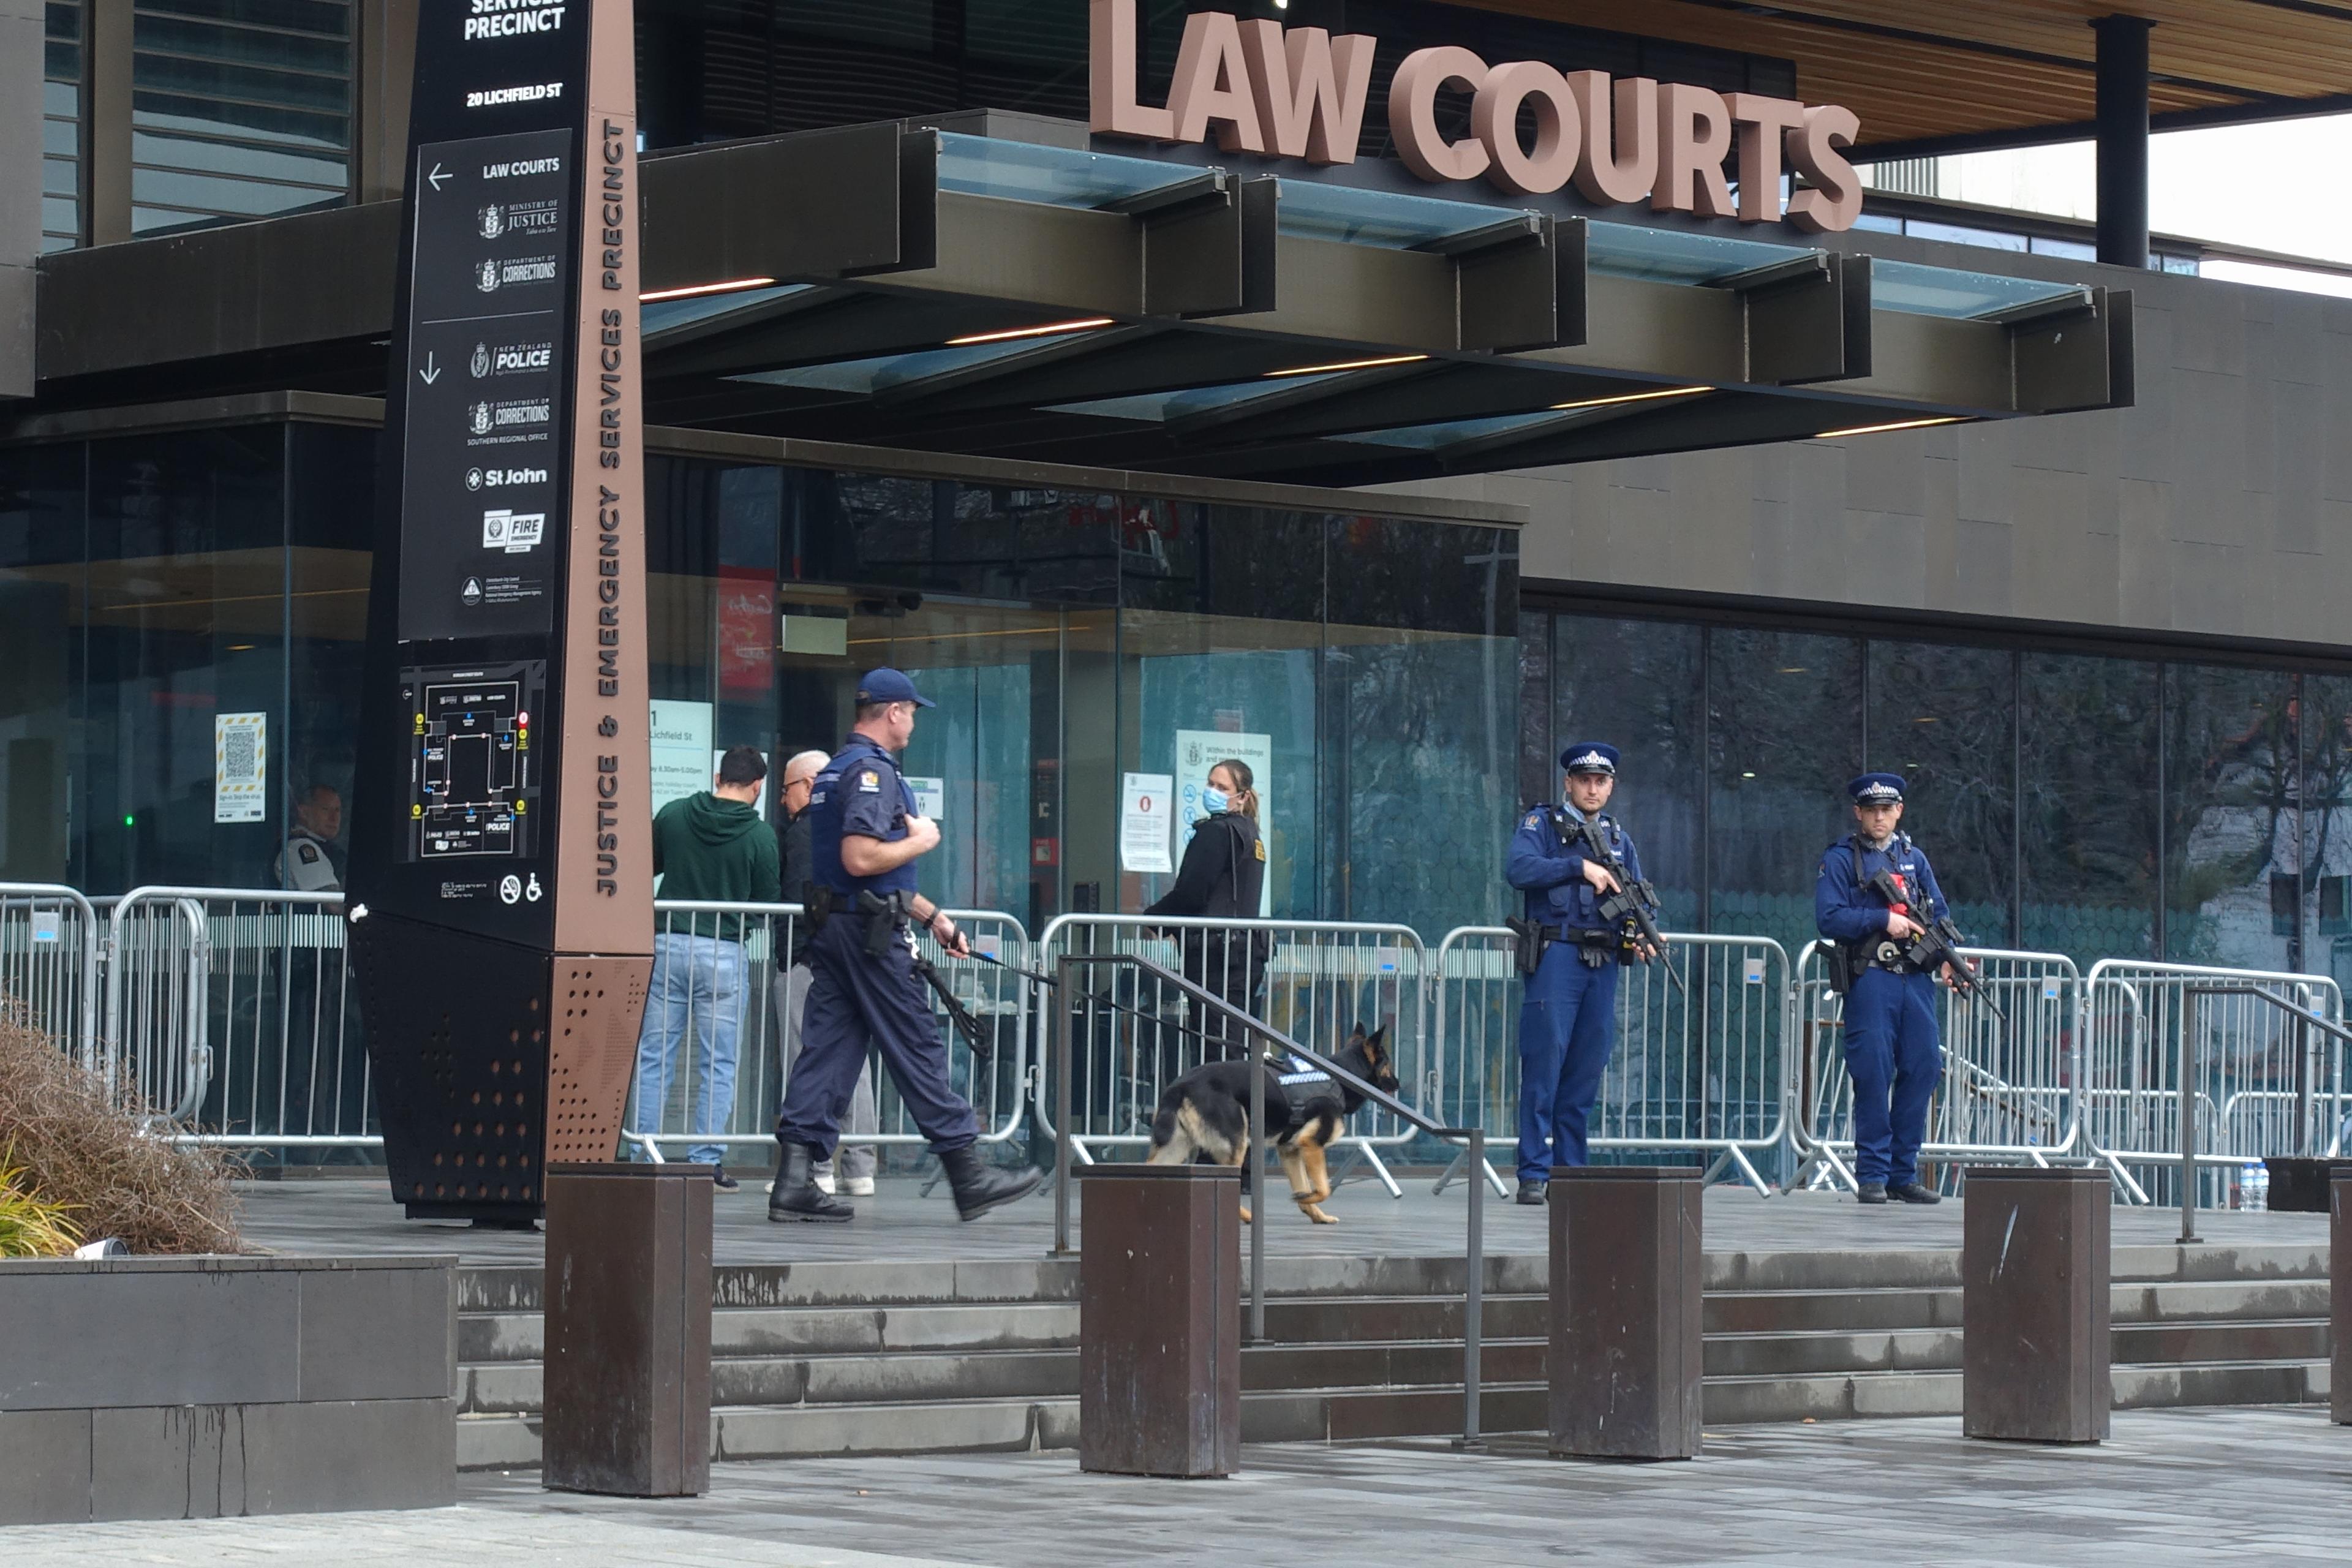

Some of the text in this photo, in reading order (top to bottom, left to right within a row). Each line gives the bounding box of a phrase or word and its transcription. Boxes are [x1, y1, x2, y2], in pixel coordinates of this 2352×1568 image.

[464, 7, 565, 40] PRECINCT
[467, 82, 563, 107] 20 LICHFIELD ST
[1089, 0, 1863, 233] LAW COURTS
[483, 157, 560, 179] LAW COURTS
[509, 200, 546, 211] MINISTRY
[507, 212, 558, 231] JUSTICE
[503, 255, 545, 265] DEPARTMENT
[503, 262, 556, 283] CORRECTIONS
[517, 342, 551, 351] ZEALAND
[497, 350, 551, 369] POLICE
[496, 399, 539, 408] DEPARTMENT
[496, 405, 549, 425] CORRECTIONS
[467, 437, 499, 446] SOUTHERN
[499, 435, 527, 443] REGIONAL
[485, 468, 547, 487] St John
[597, 118, 624, 897] JUSTICE & EMERGENCY SERVICES PRECINCT
[512, 519, 540, 534] FIRE
[1237, 748, 1264, 758] buildings
